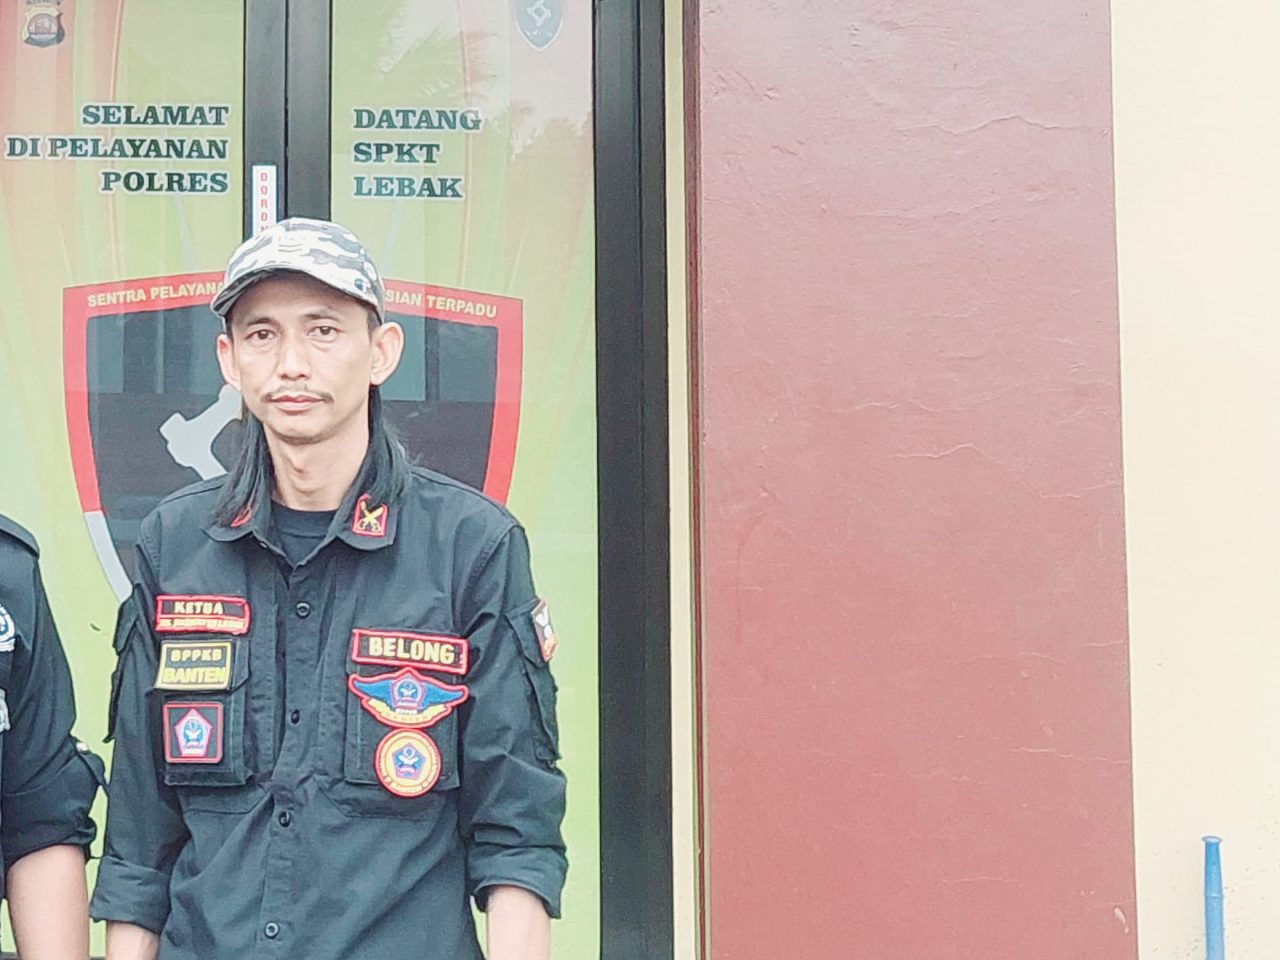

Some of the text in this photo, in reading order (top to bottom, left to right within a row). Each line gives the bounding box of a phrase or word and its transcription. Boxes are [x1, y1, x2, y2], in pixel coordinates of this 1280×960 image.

[81, 104, 230, 126] SELAMAT
[352, 108, 484, 131] DATANG
[6, 136, 229, 160] DI PELAYANAN
[352, 141, 441, 164] SPKT
[100, 171, 229, 194] POLRES
[352, 175, 464, 198] LEBAK
[87, 290, 147, 308] SENTRA
[425, 294, 498, 319] TERPADU
[368, 636, 456, 666] BELONG
[163, 666, 226, 685] BANTEN
